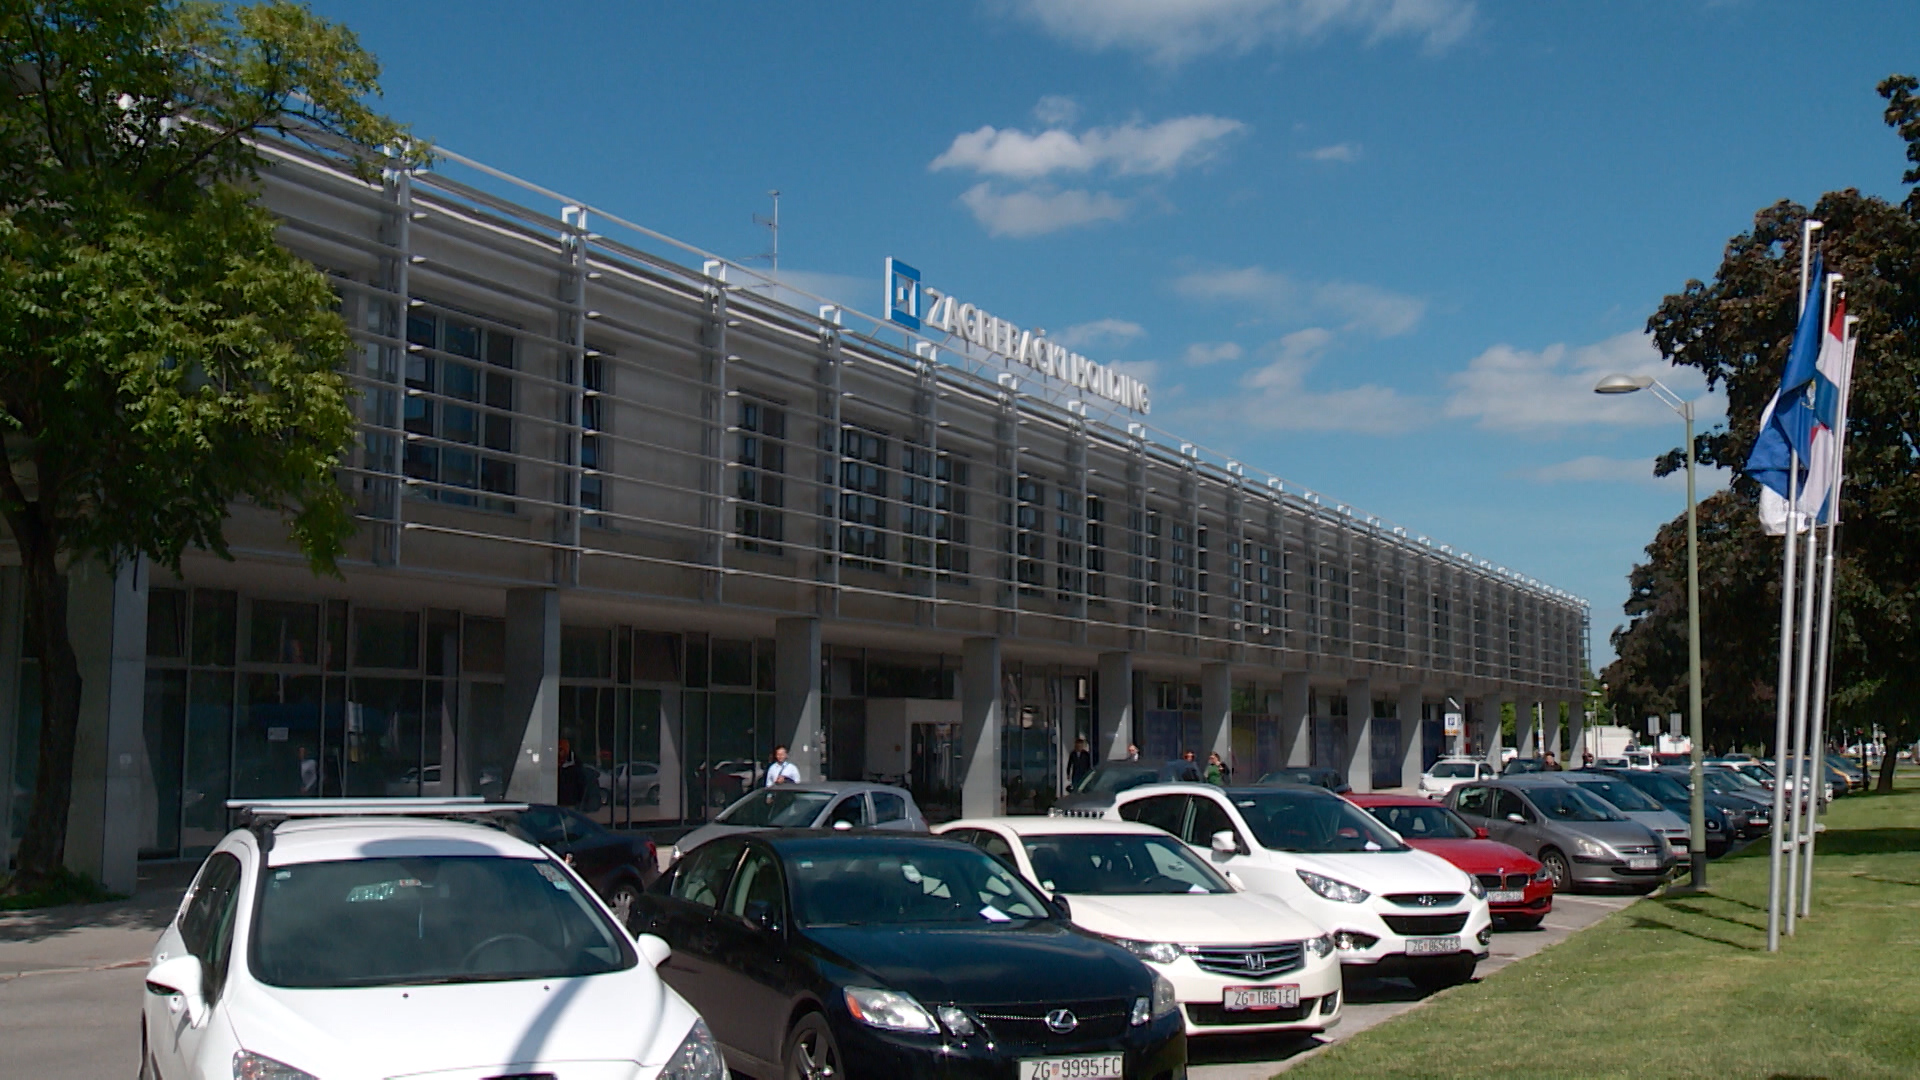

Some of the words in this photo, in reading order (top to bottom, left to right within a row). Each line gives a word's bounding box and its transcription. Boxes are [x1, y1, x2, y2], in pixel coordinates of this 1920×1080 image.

[925, 287, 1066, 380] ZAGREBAČKI
[1070, 352, 1151, 415] HOLDING
[1061, 1057, 1121, 1078] 9995-FC
